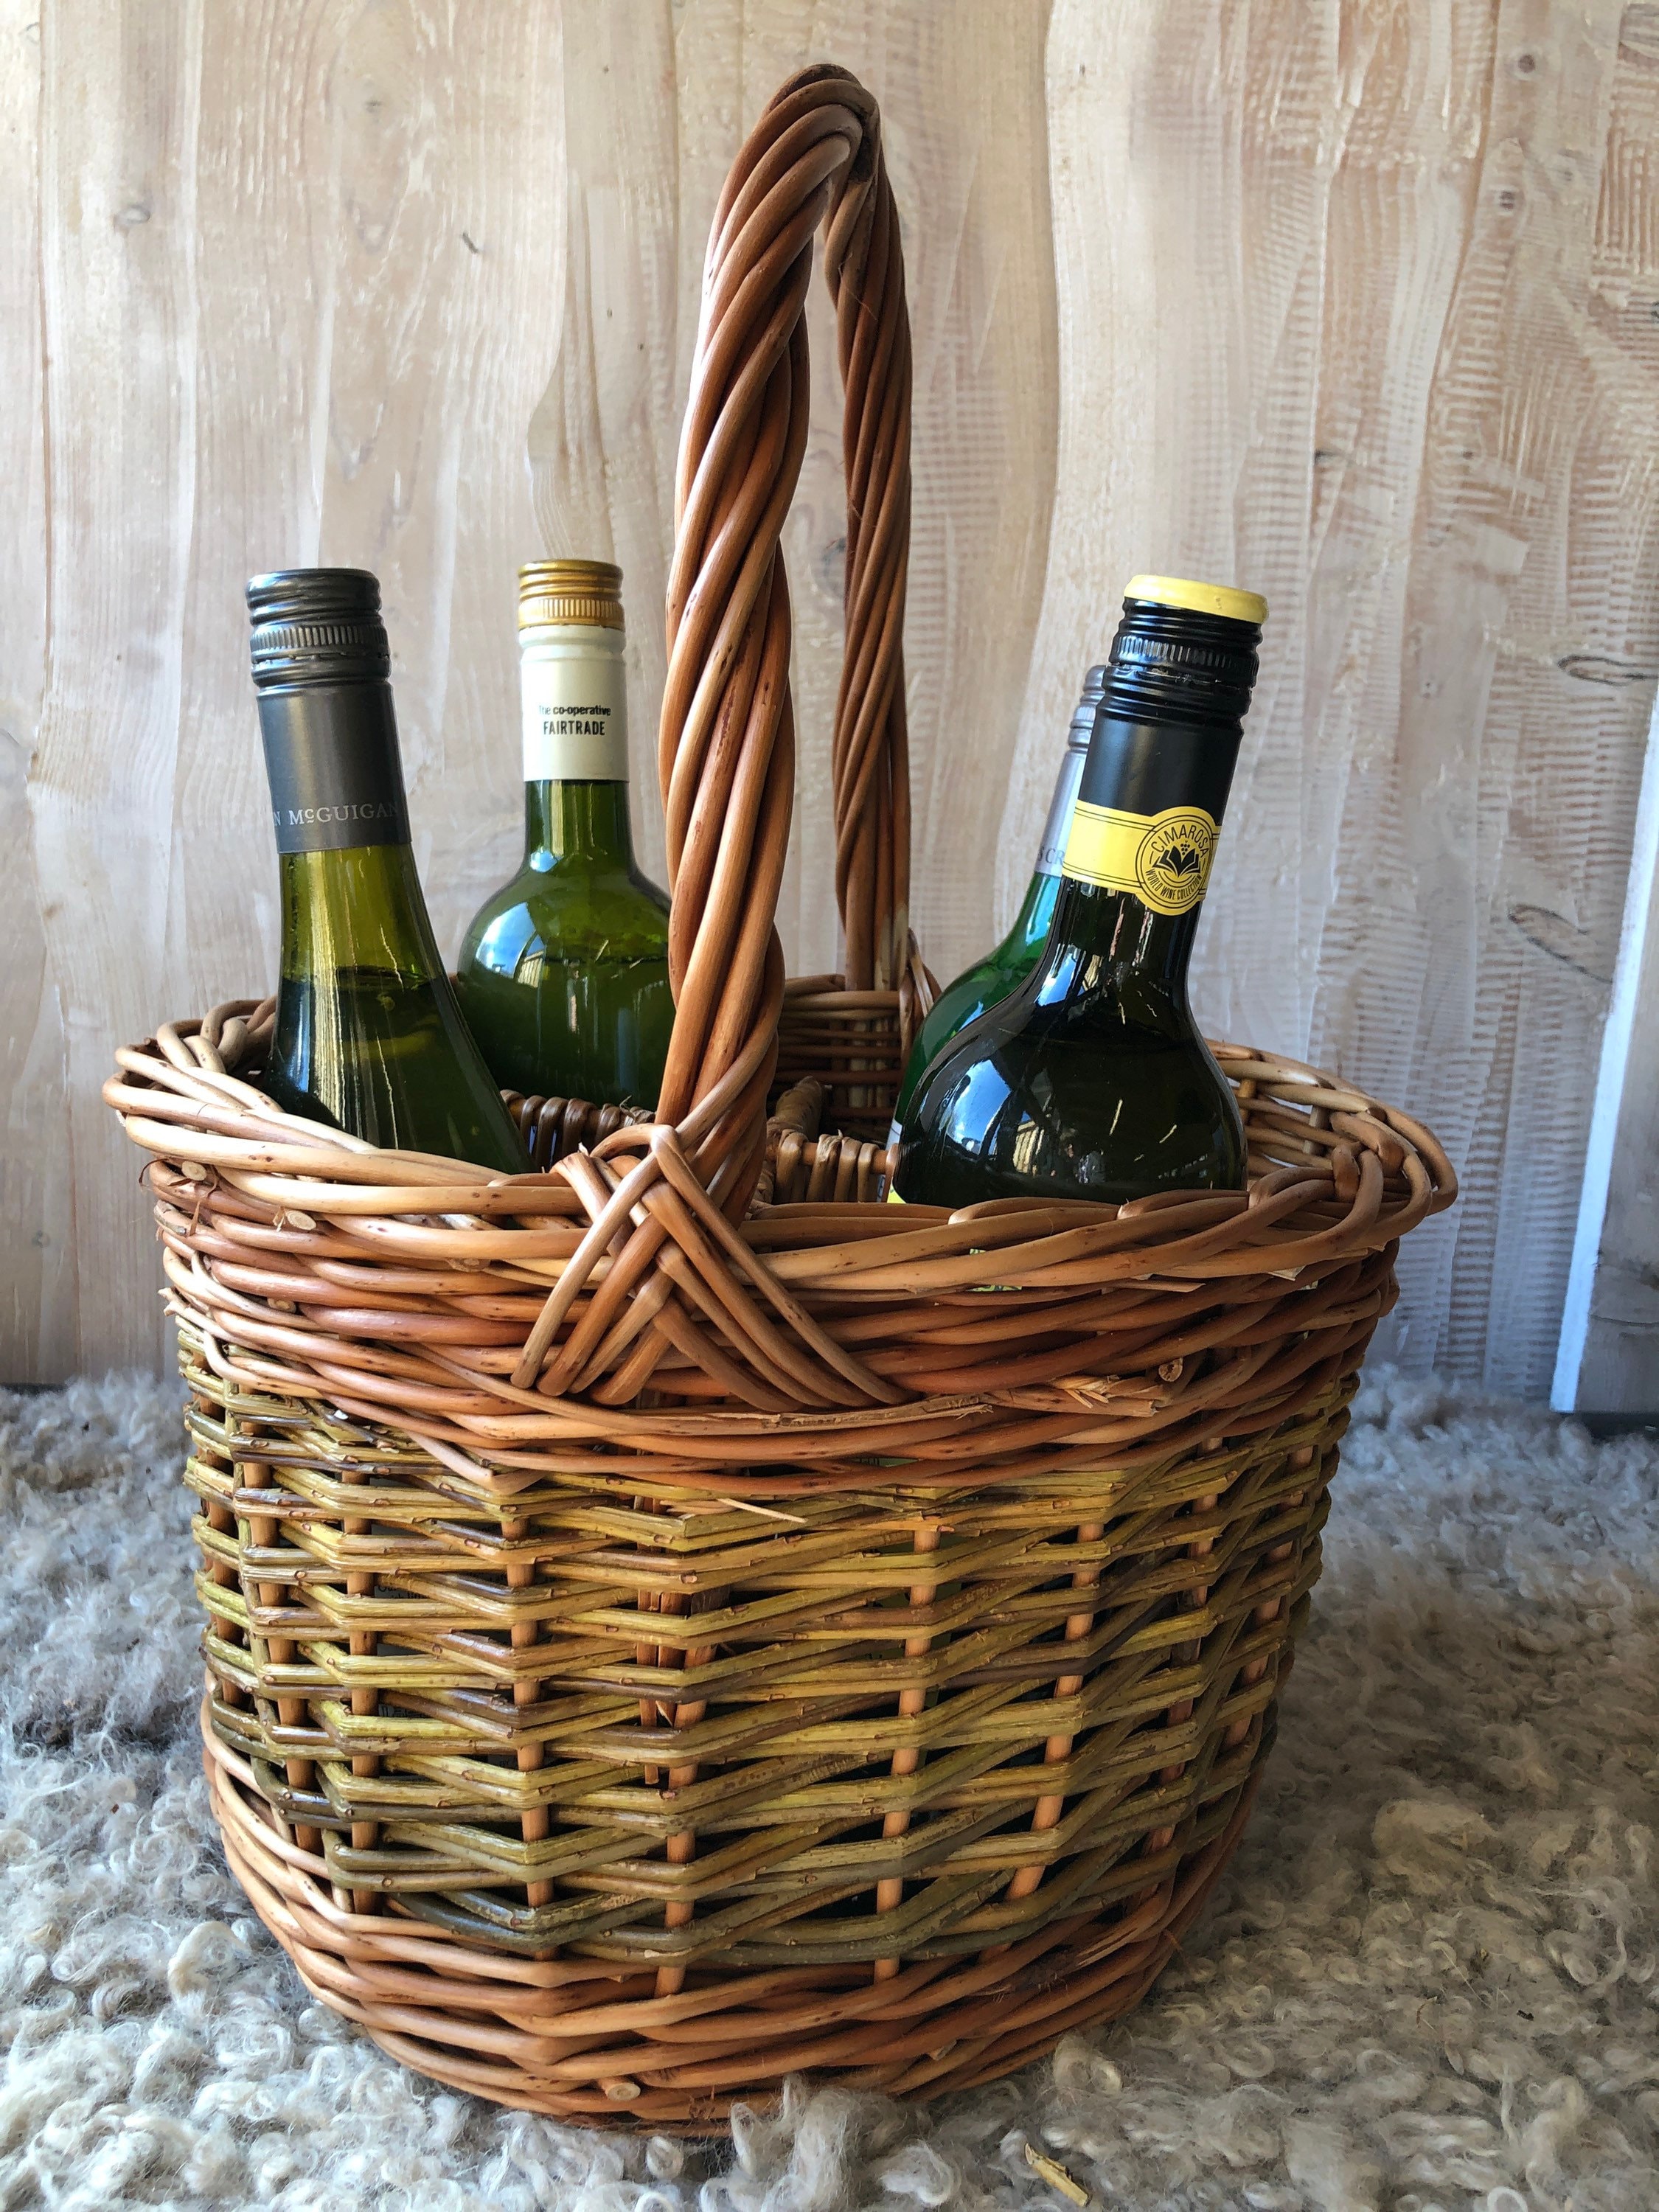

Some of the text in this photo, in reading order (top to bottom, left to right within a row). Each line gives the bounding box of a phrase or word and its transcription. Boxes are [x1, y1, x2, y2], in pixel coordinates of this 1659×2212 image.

[553, 705, 611, 716] co-operative
[543, 720, 605, 736] FAIRTRADE
[1151, 824, 1208, 858] CIMAROSA
[1145, 869, 1202, 900] WORLD WINE COLLECTION
